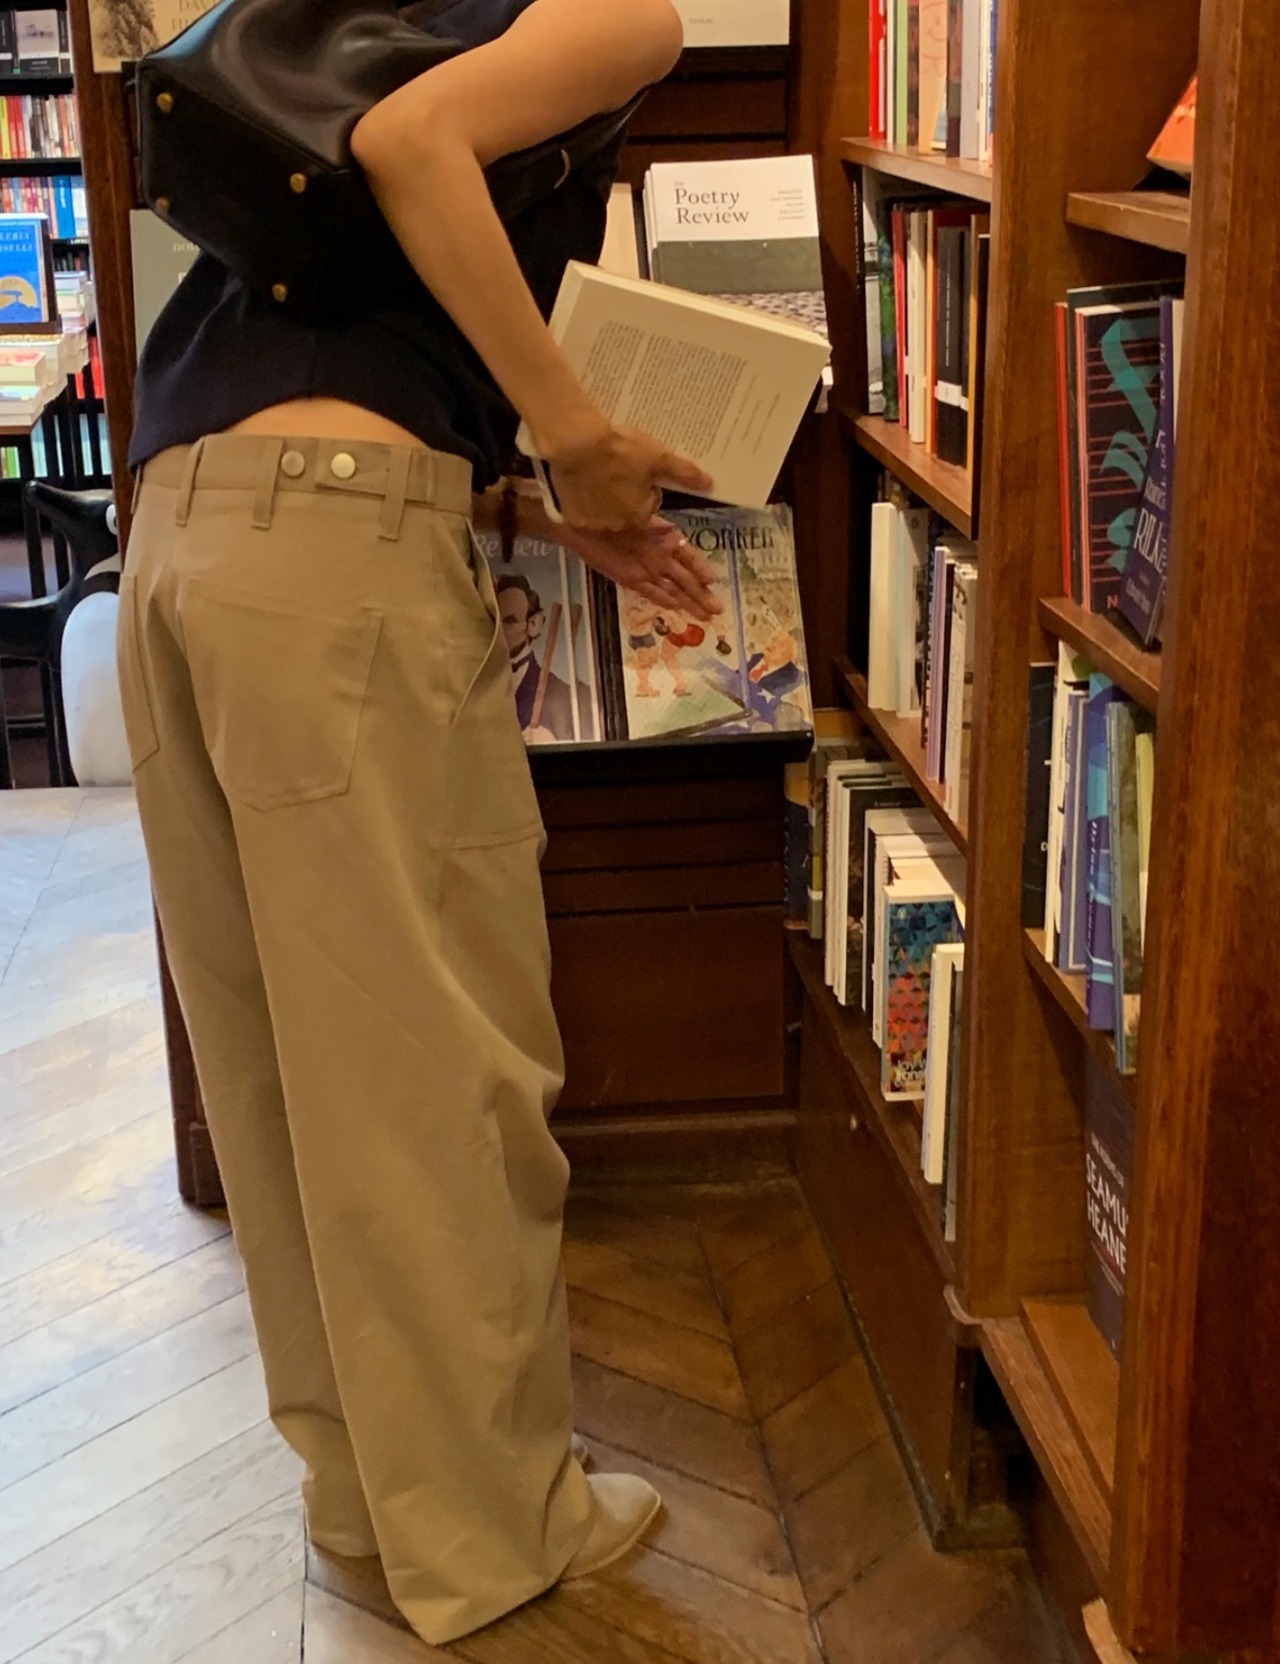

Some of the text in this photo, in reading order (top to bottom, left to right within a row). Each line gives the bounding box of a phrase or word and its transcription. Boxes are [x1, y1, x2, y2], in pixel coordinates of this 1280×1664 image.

[674, 187, 740, 210] Poetry
[676, 206, 749, 224] Review
[682, 527, 775, 551] YORKER
[1086, 1153, 1129, 1237] SEAMU
